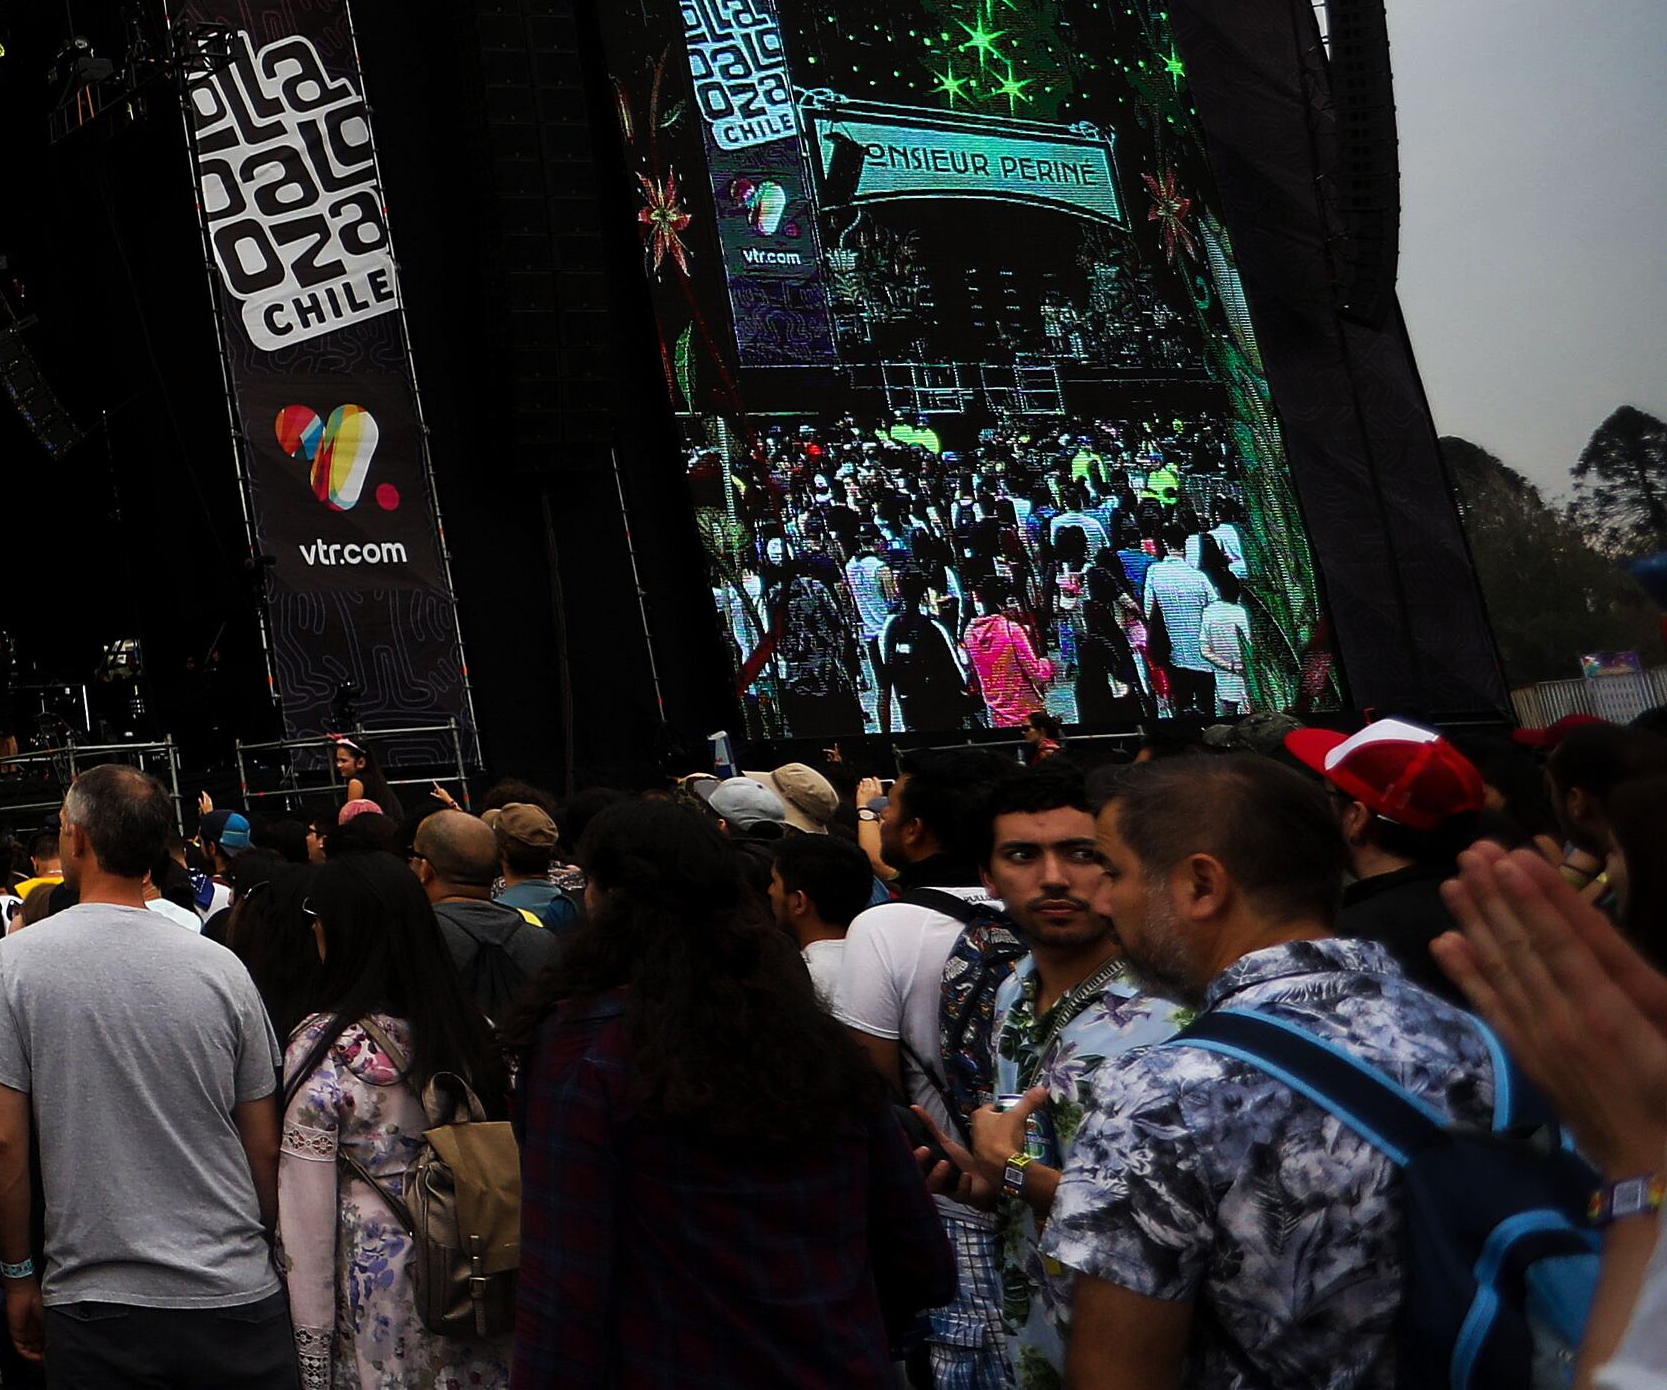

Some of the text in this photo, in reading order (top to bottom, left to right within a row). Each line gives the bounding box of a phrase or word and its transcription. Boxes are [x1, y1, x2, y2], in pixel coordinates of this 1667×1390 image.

[723, 112, 795, 144] CHILE
[867, 142, 1098, 186] ONSIEUR PERINÉ
[742, 247, 802, 265] vtr.com
[263, 267, 396, 337] CHILE
[299, 538, 409, 566] vtr.com
